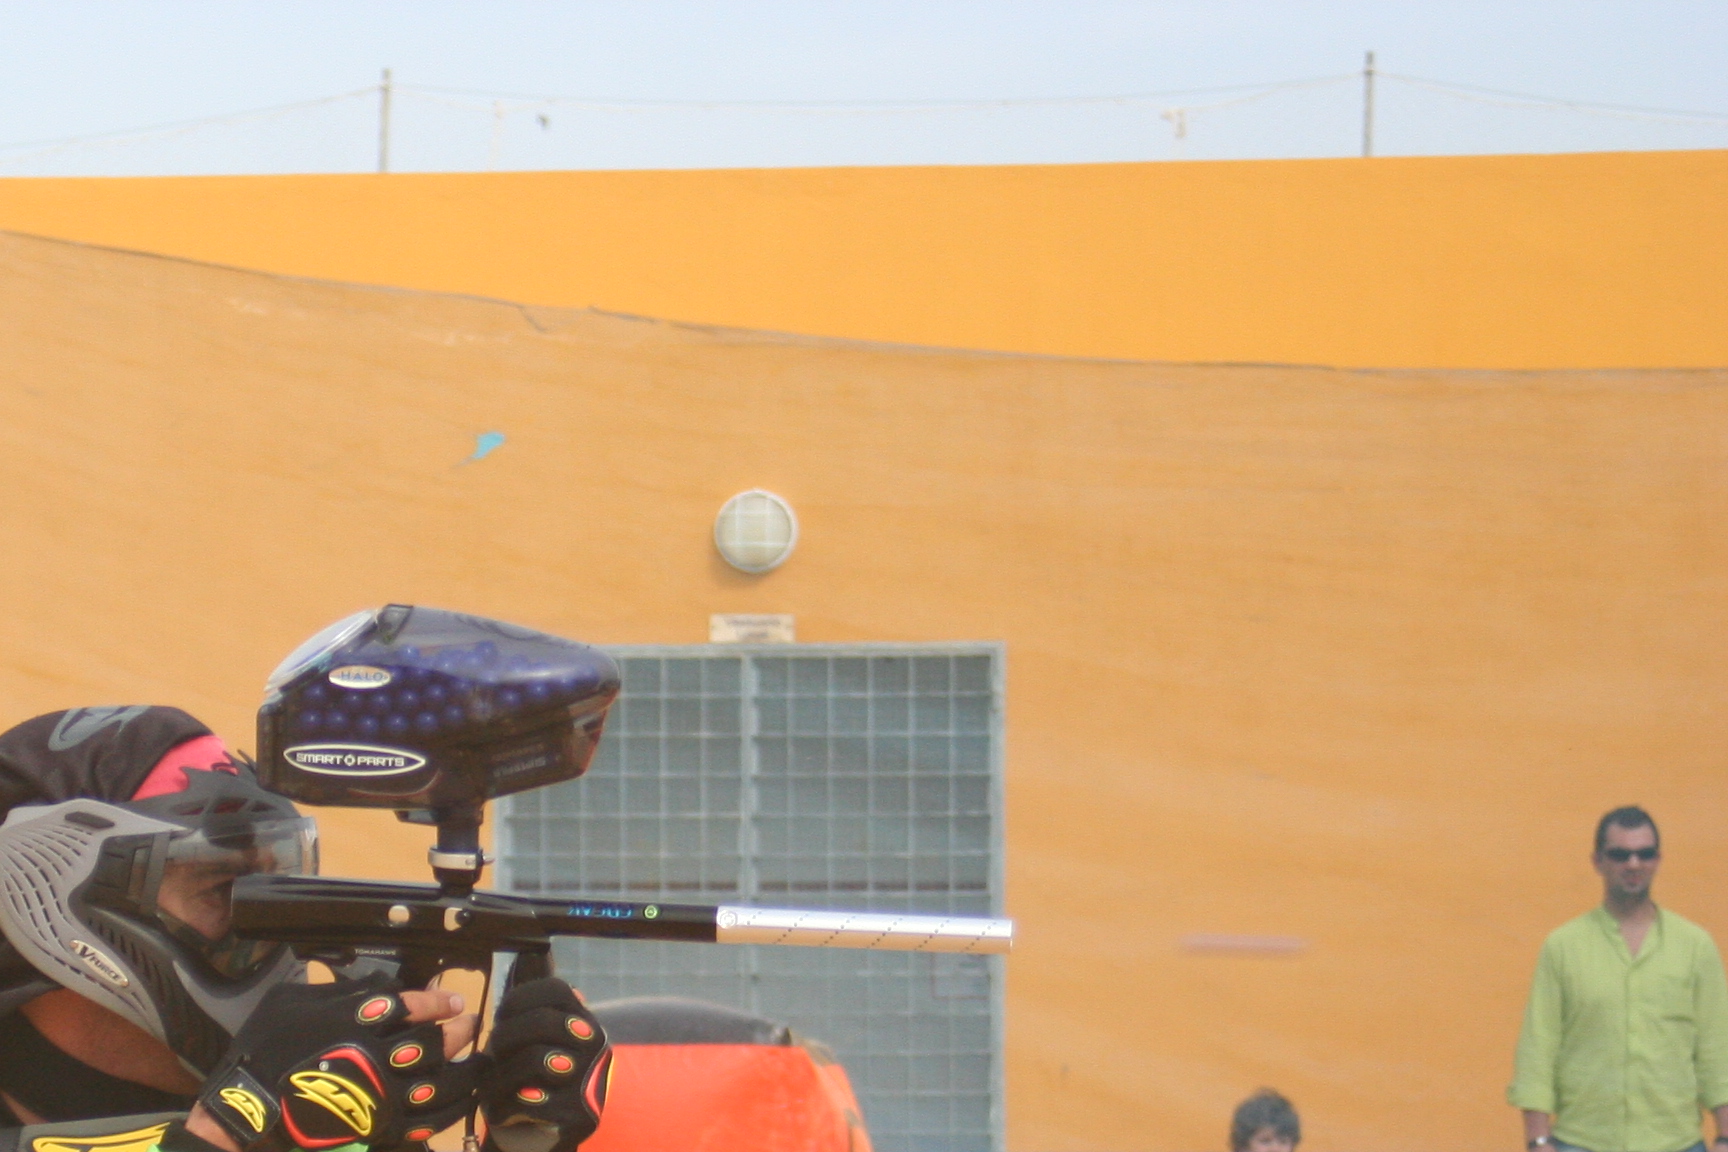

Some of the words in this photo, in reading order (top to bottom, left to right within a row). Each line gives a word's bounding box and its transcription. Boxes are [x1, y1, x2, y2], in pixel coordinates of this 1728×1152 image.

[340, 671, 385, 682] HALO
[295, 752, 343, 765] SMART
[357, 755, 405, 767] PARTS
